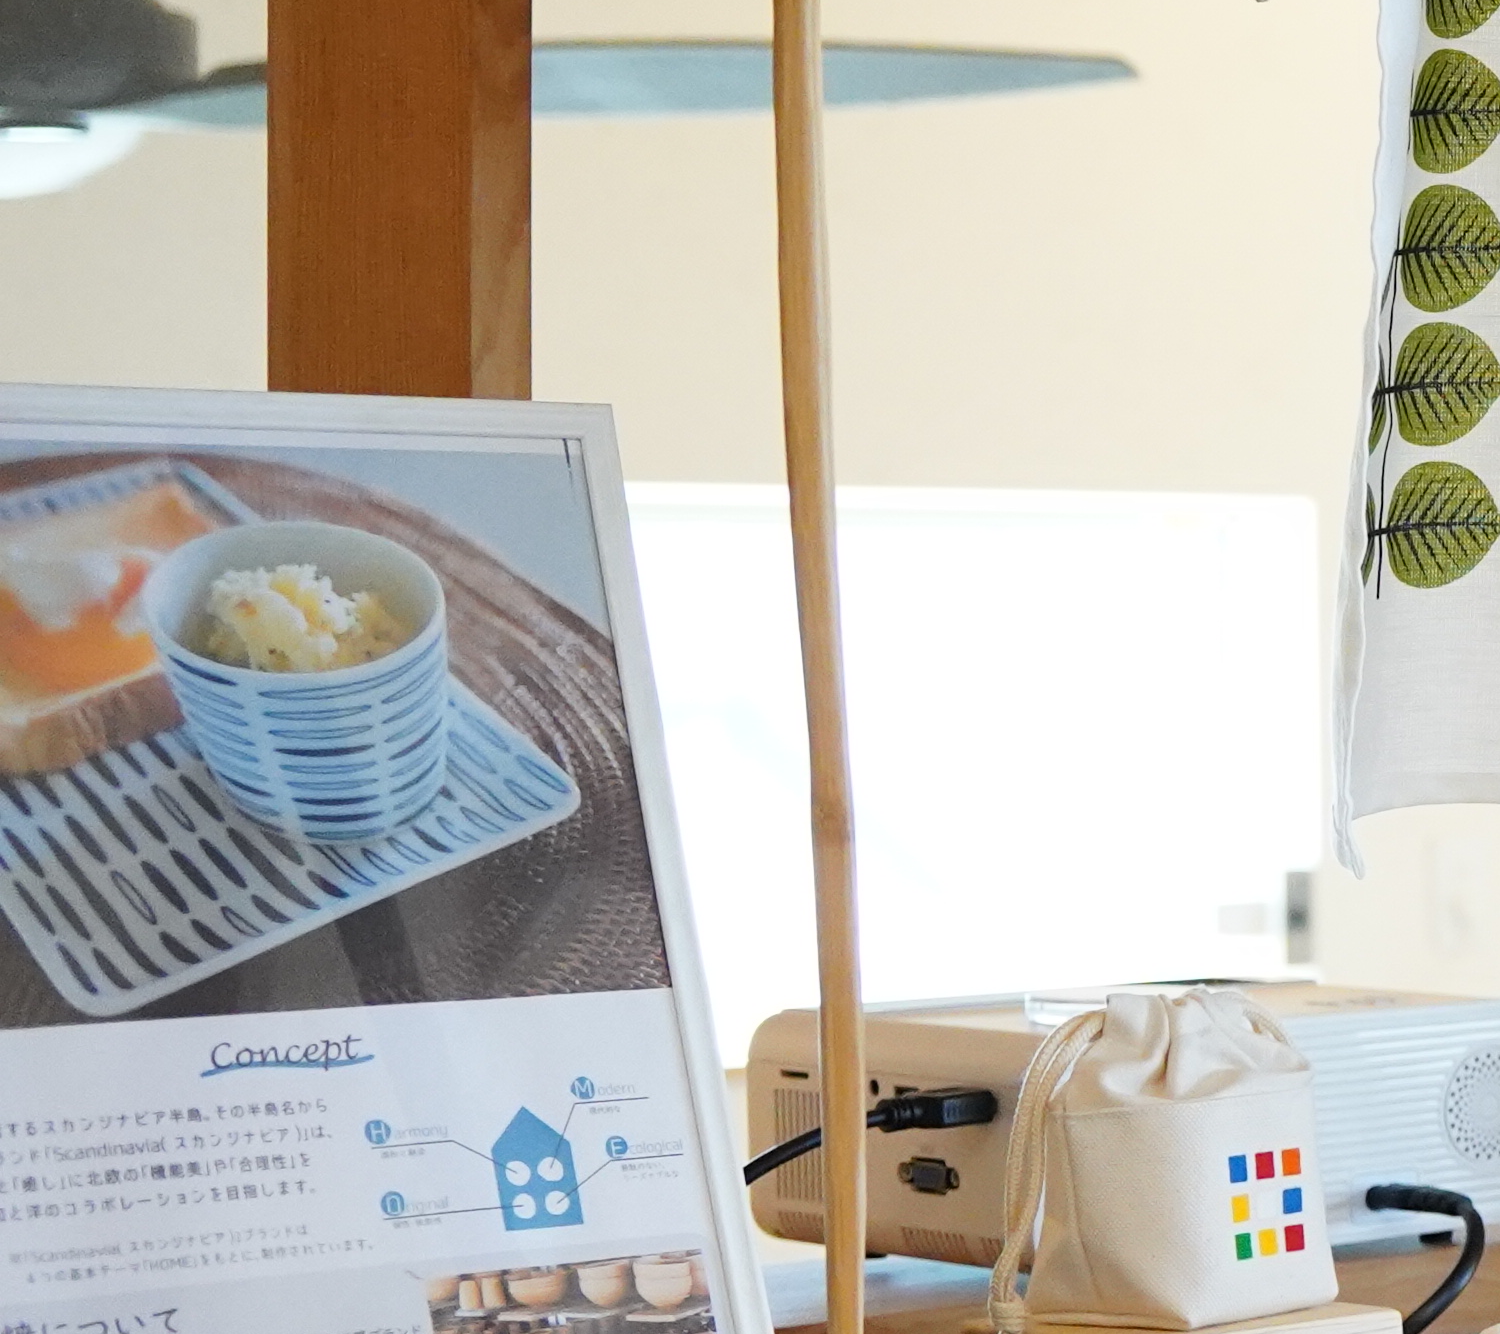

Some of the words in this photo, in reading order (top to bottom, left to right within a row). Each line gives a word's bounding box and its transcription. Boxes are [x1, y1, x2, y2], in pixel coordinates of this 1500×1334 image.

[210, 1034, 362, 1070] Concept
[573, 1077, 636, 1099] Modern
[0, 1098, 328, 1138] するスカンジナビア半島。その半島名から
[367, 1120, 448, 1143] Harmony
[607, 1136, 684, 1157] Ecological
[384, 1192, 450, 1216] Original
